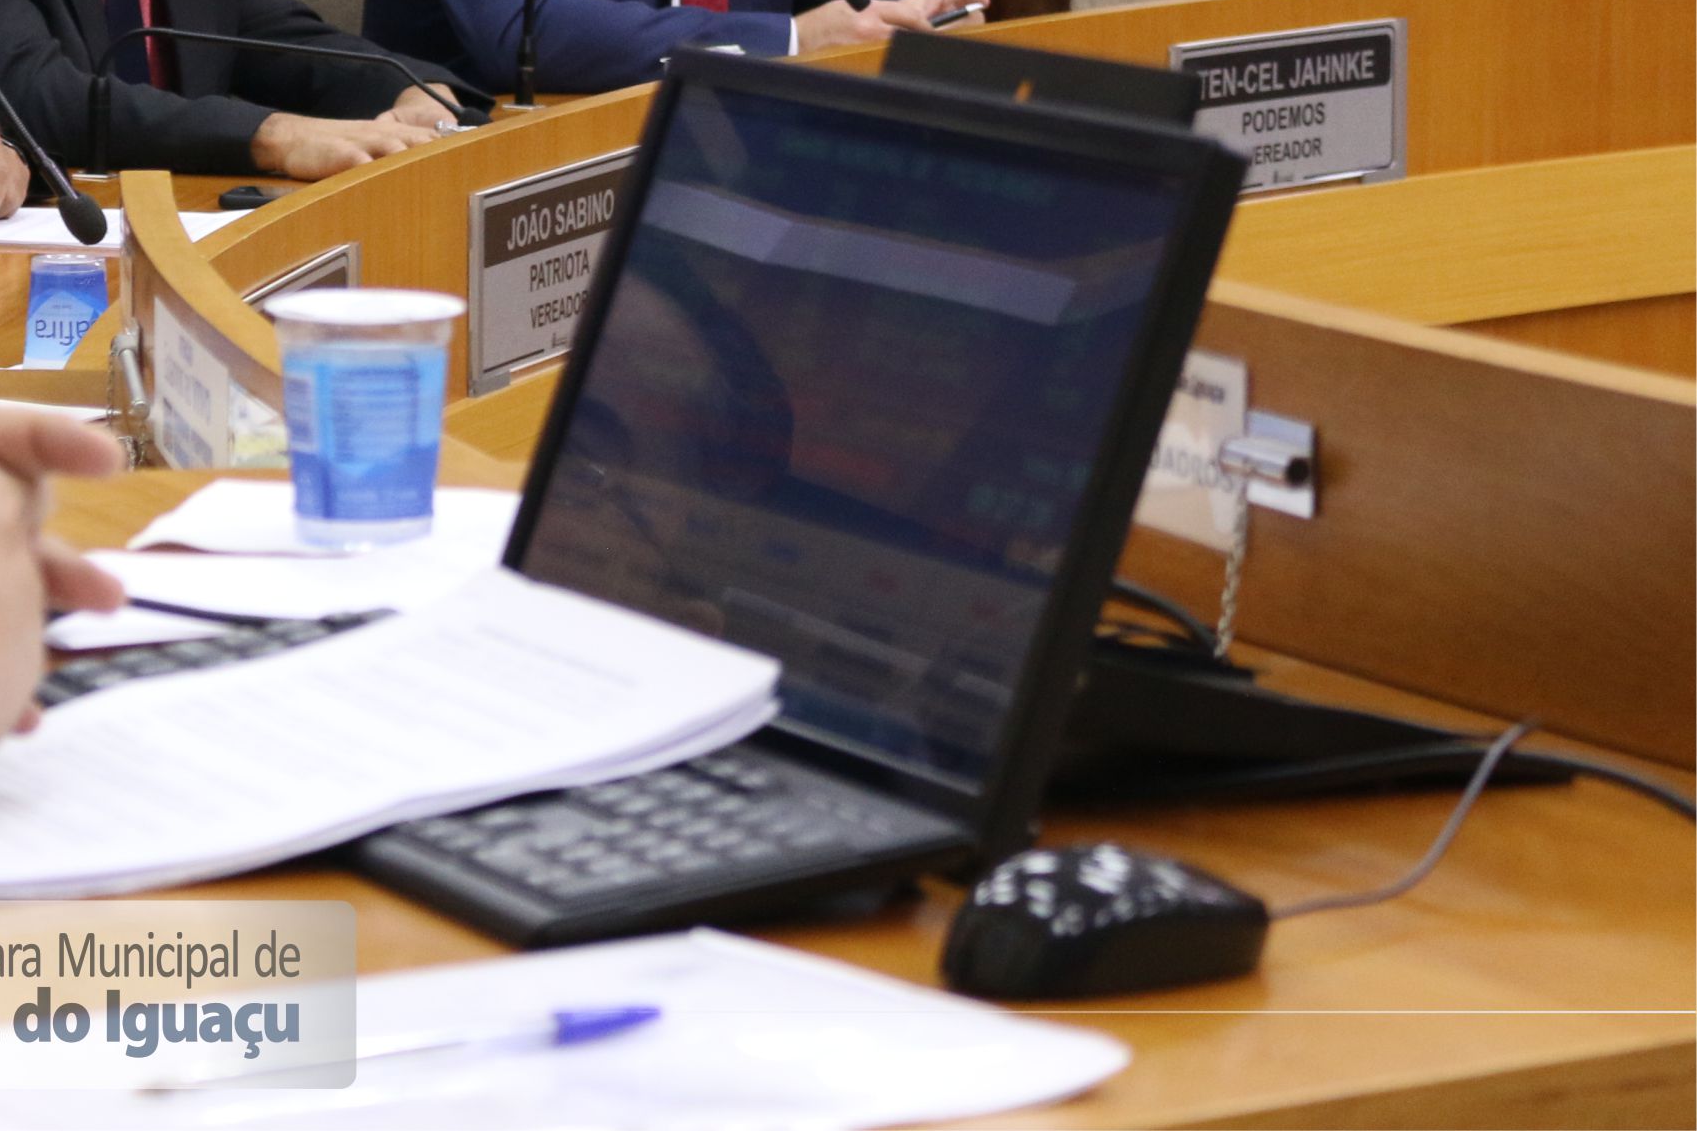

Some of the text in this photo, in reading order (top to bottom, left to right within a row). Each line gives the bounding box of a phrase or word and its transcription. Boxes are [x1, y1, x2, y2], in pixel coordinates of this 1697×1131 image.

[1196, 49, 1375, 101] TEN-CEL JAHNKE
[1242, 102, 1325, 135] PODEMOS
[507, 188, 615, 251] JOÃO SABINO
[530, 248, 590, 292] PATRIOTA
[35, 319, 96, 346] afira
